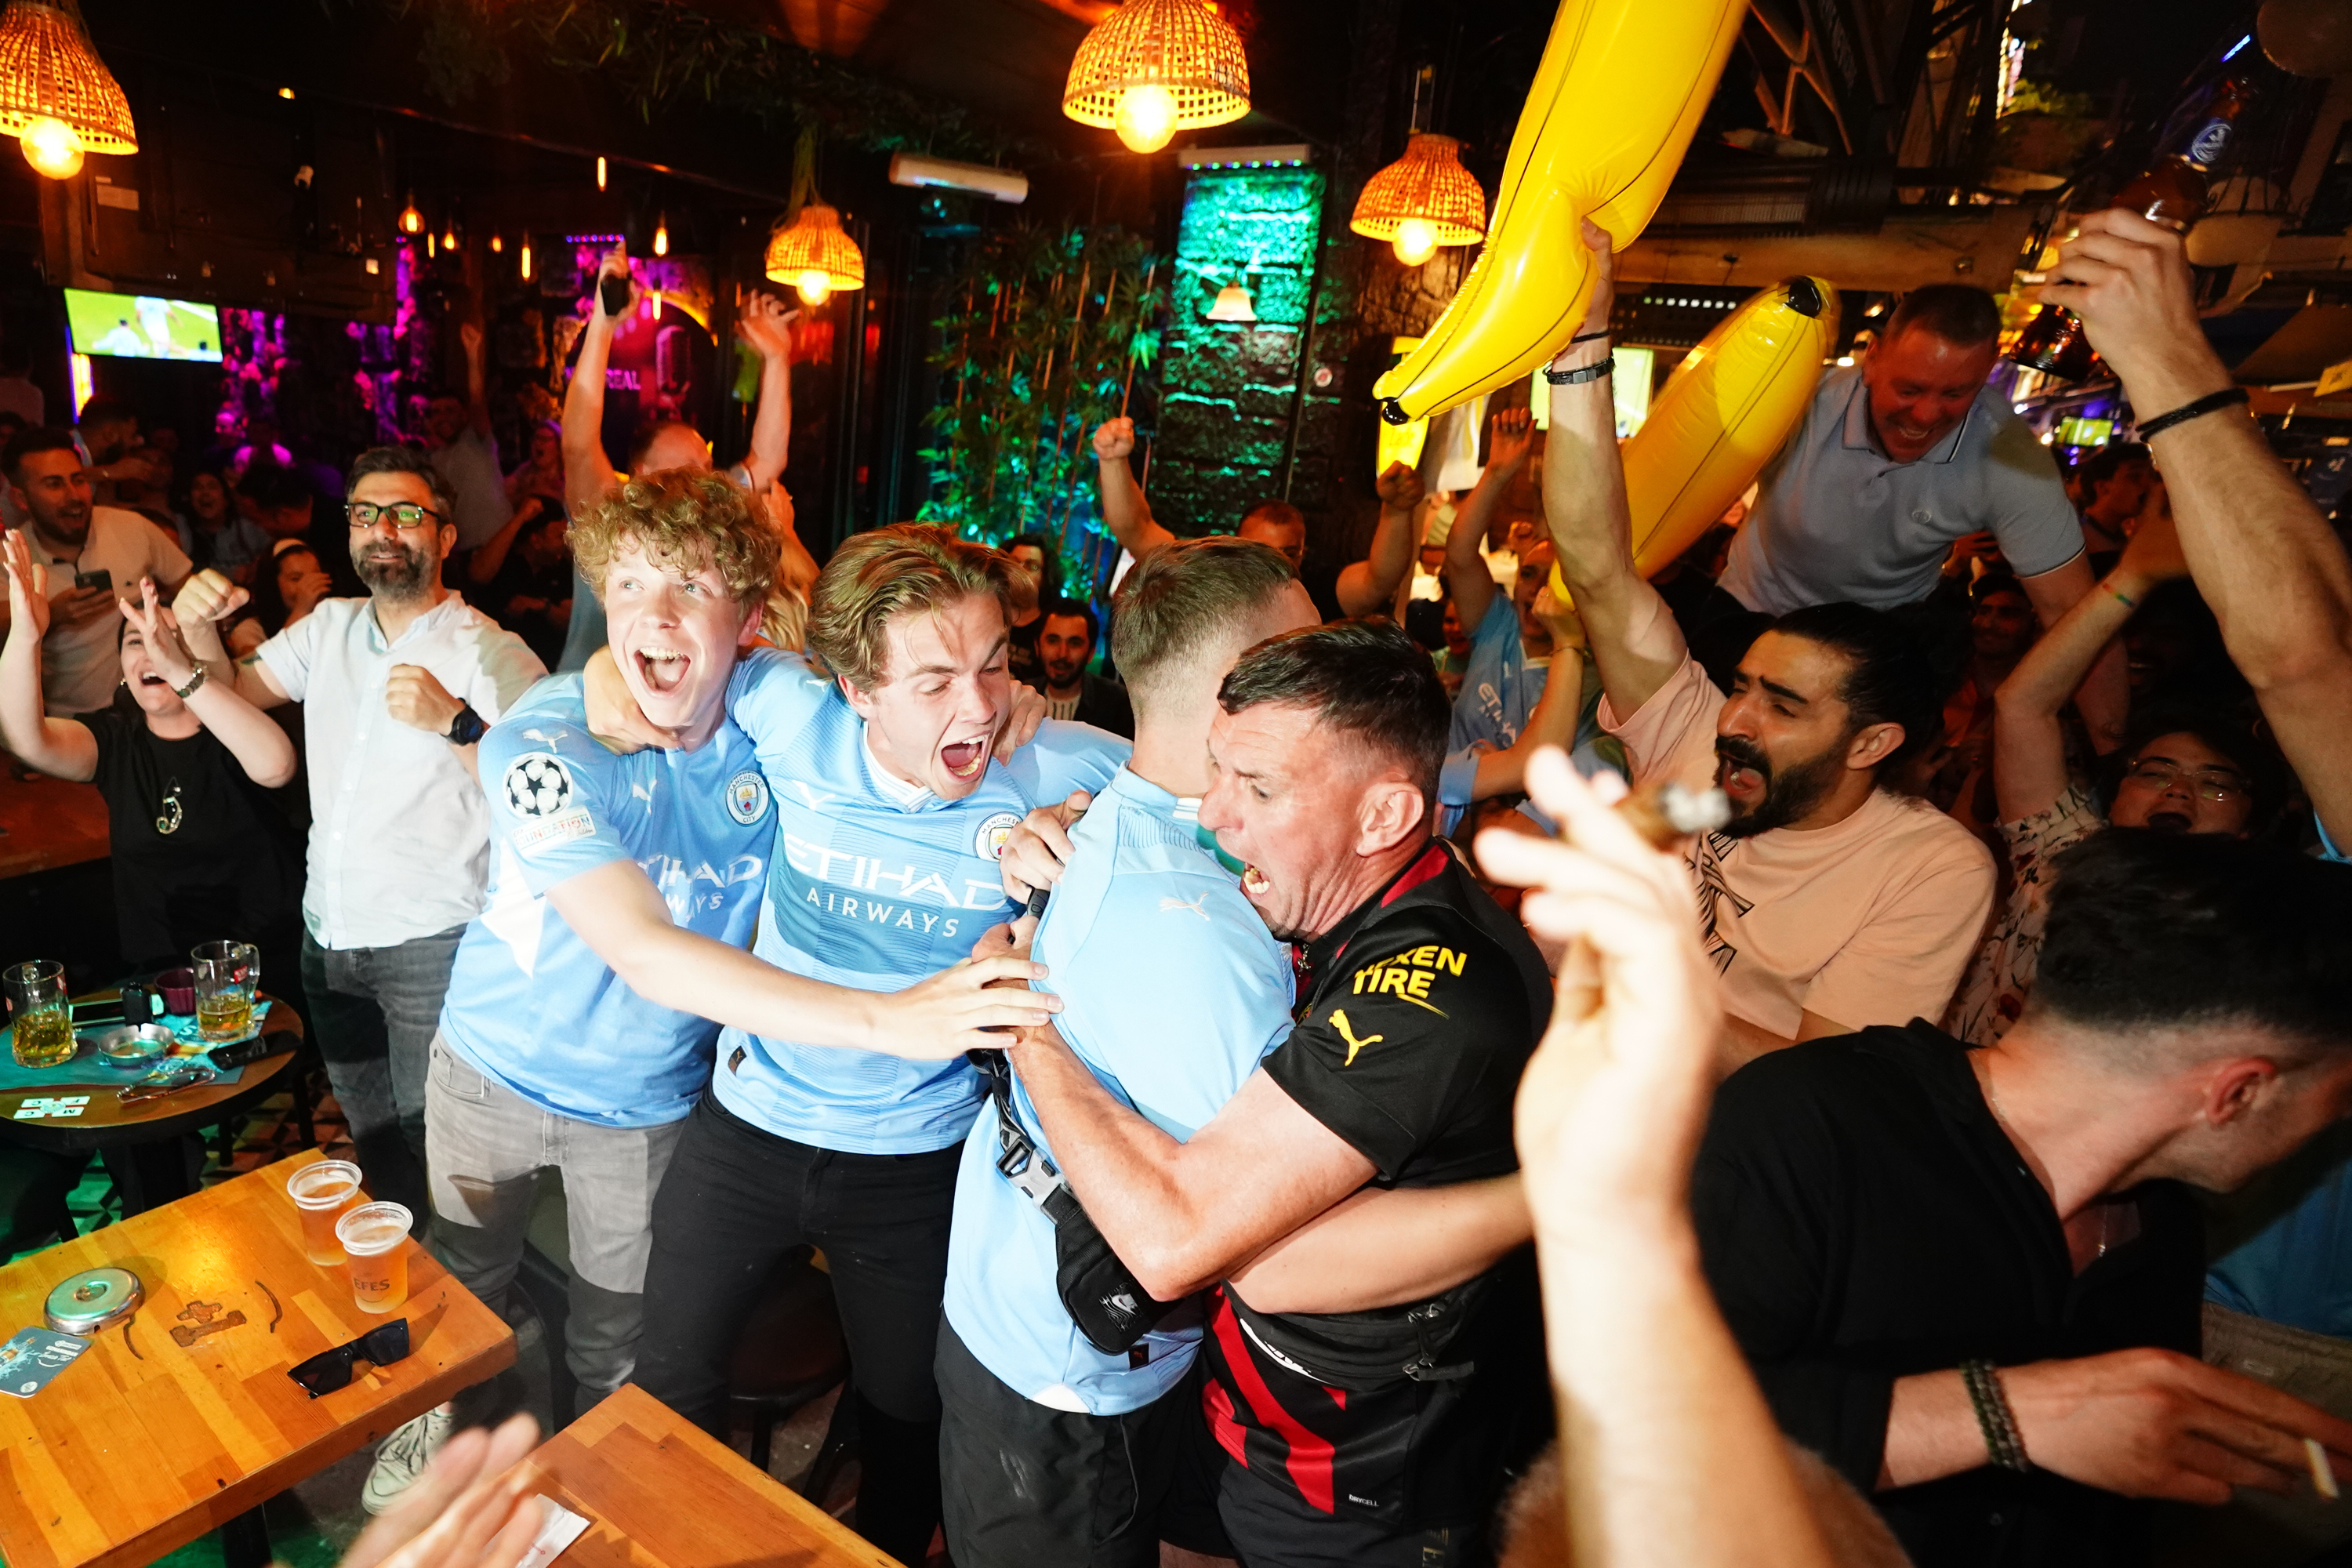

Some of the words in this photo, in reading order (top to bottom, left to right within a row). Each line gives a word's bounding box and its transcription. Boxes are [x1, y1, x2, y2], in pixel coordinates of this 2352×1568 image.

[729, 775, 764, 795] MANCHESTER
[785, 833, 1007, 911] ETIHAD
[806, 887, 960, 938] AIRWAYS
[1352, 967, 1436, 1000] TIRE
[353, 1276, 390, 1292] EFES
[1348, 1494, 1380, 1507] DRYCELL
